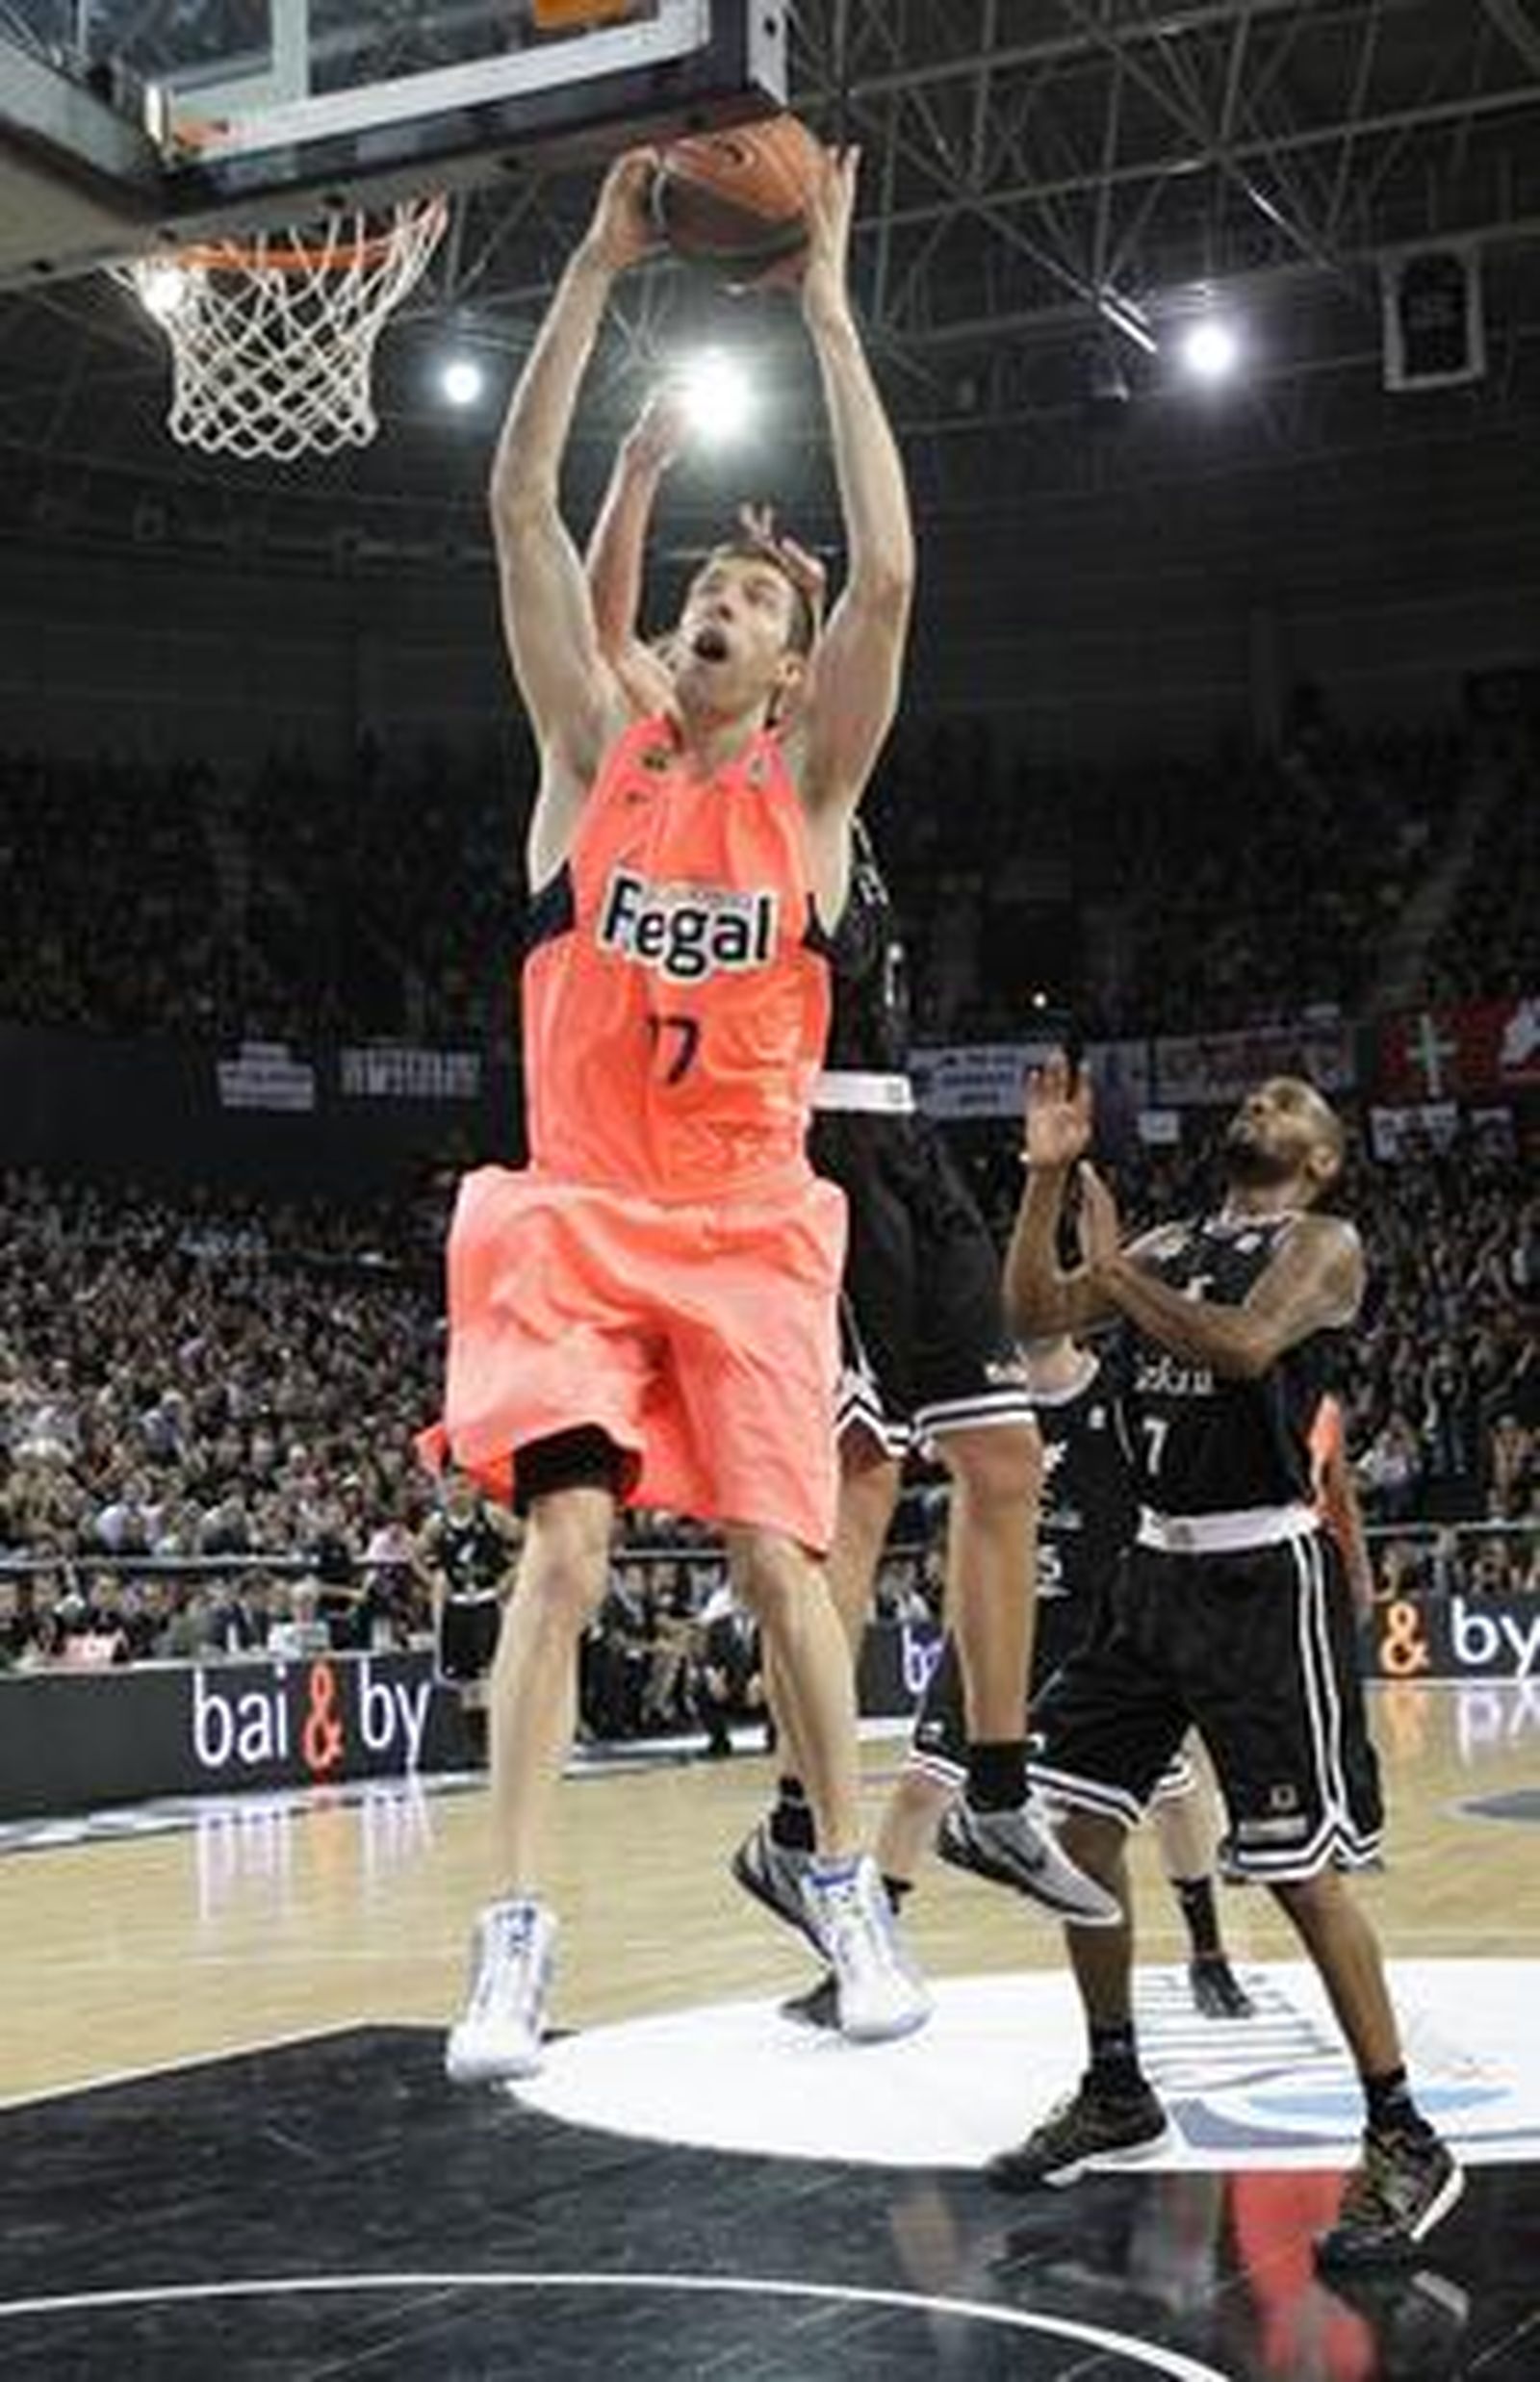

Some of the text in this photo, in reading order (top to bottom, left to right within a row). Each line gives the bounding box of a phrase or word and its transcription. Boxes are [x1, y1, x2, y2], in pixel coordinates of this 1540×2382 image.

[603, 876, 771, 978] Fegal
[1142, 1417, 1168, 1475] 7
[1380, 1596, 1540, 1678] & by
[193, 1655, 432, 1778] bai & by
